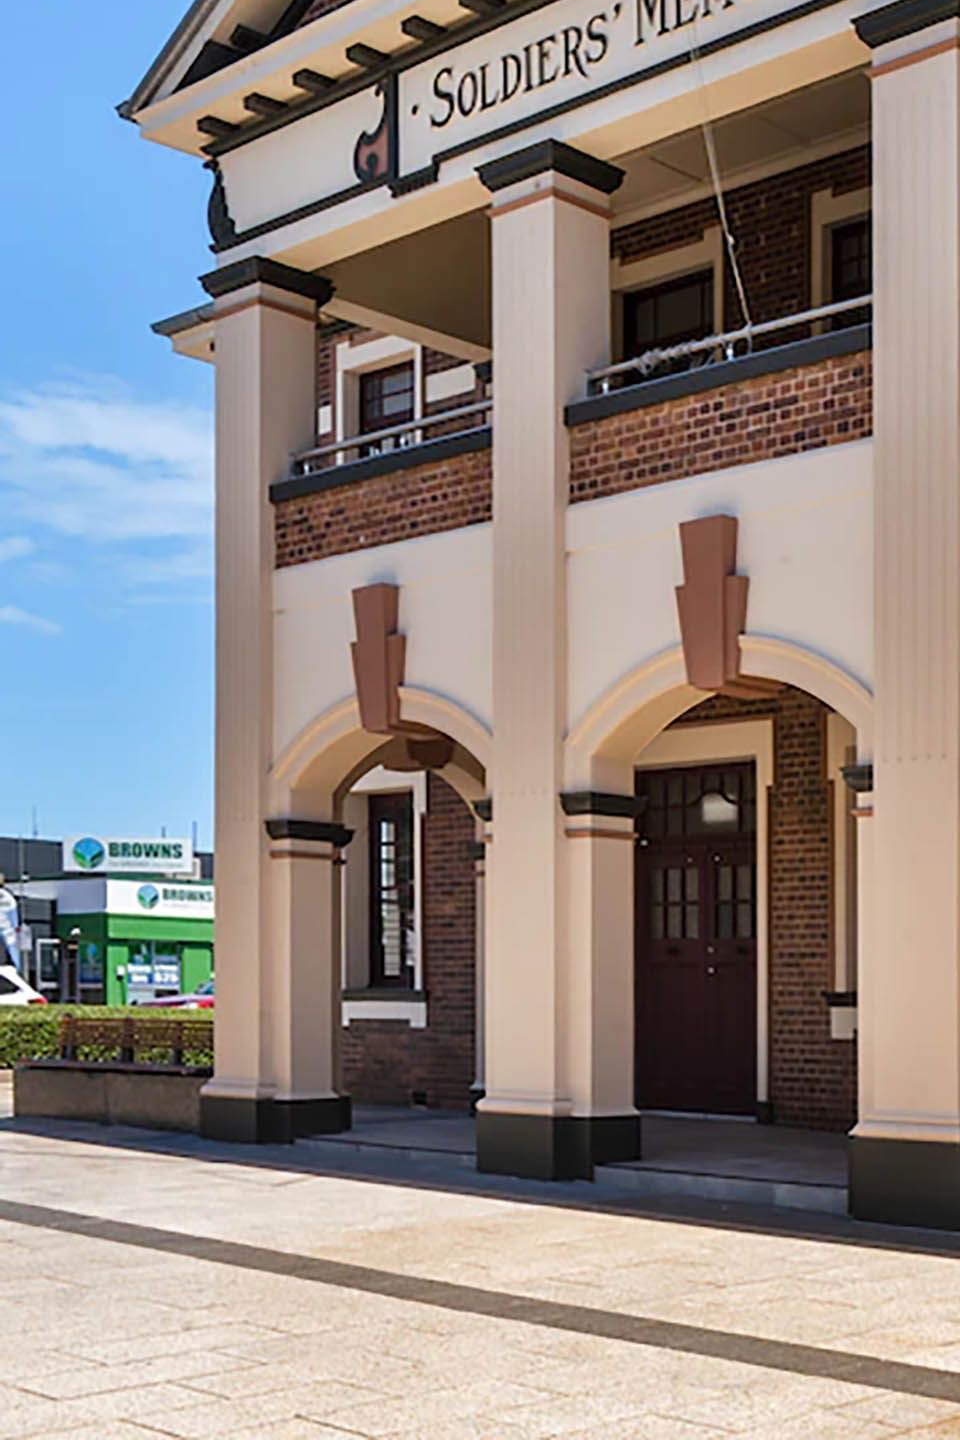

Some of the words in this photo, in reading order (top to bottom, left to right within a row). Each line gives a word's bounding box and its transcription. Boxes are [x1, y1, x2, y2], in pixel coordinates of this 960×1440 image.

[429, 3, 622, 128] SOLDIERS'
[108, 841, 183, 860] BROWNS
[162, 887, 214, 903] BROWNS
